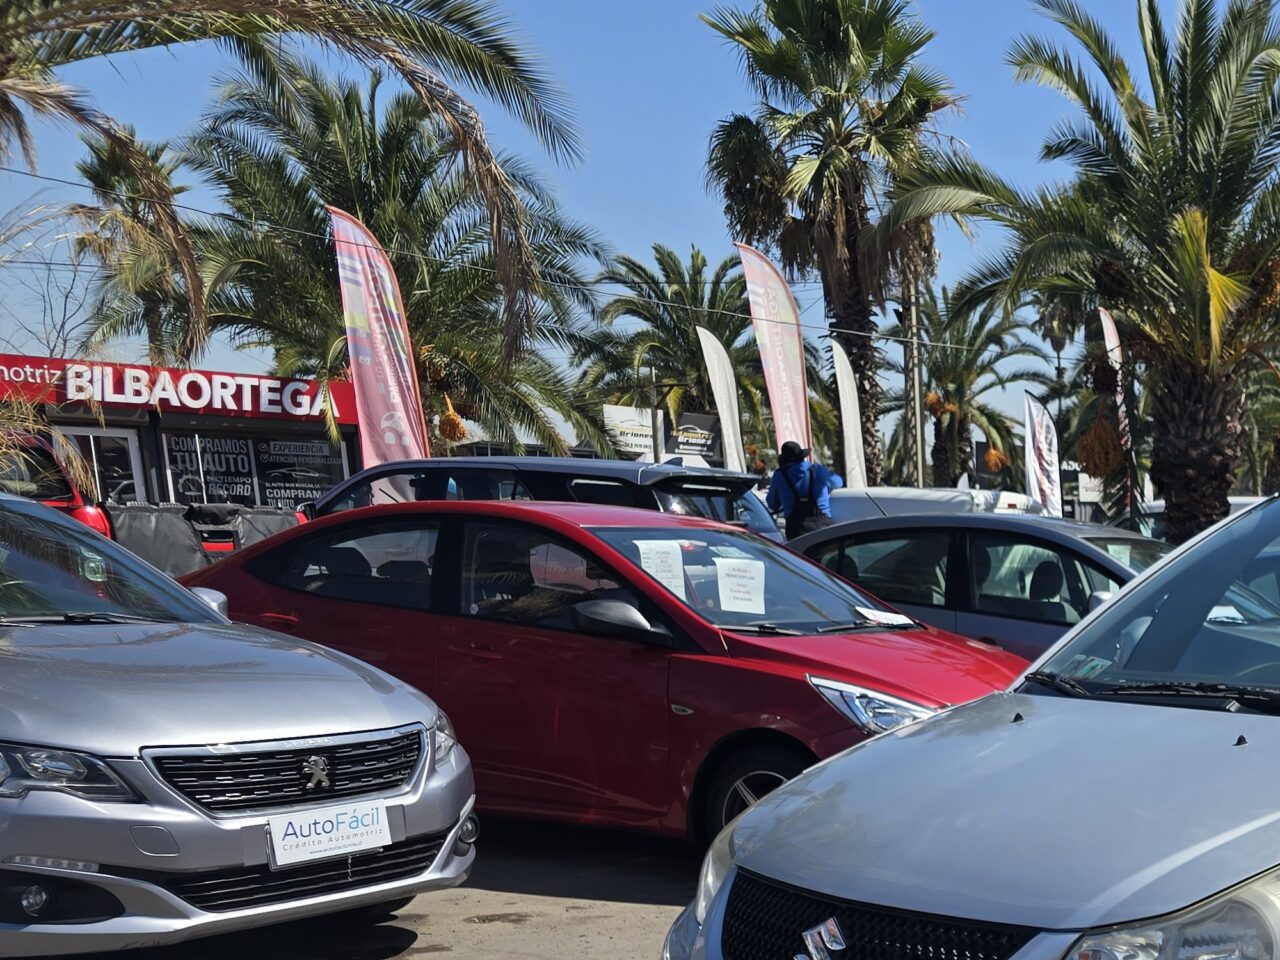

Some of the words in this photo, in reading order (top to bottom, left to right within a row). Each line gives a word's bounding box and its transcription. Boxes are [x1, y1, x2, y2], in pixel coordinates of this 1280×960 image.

[65, 363, 340, 418] BILBAORTEGA
[171, 437, 247, 453] COMPRAMOS
[271, 443, 324, 454] EXPERIENCIA
[173, 452, 198, 471] TU
[203, 452, 249, 473] AUTO
[208, 483, 252, 496] RECORD
[281, 806, 381, 842] AutoFácil
[282, 838, 322, 852] Crédito
[327, 828, 384, 843] Automotriz
